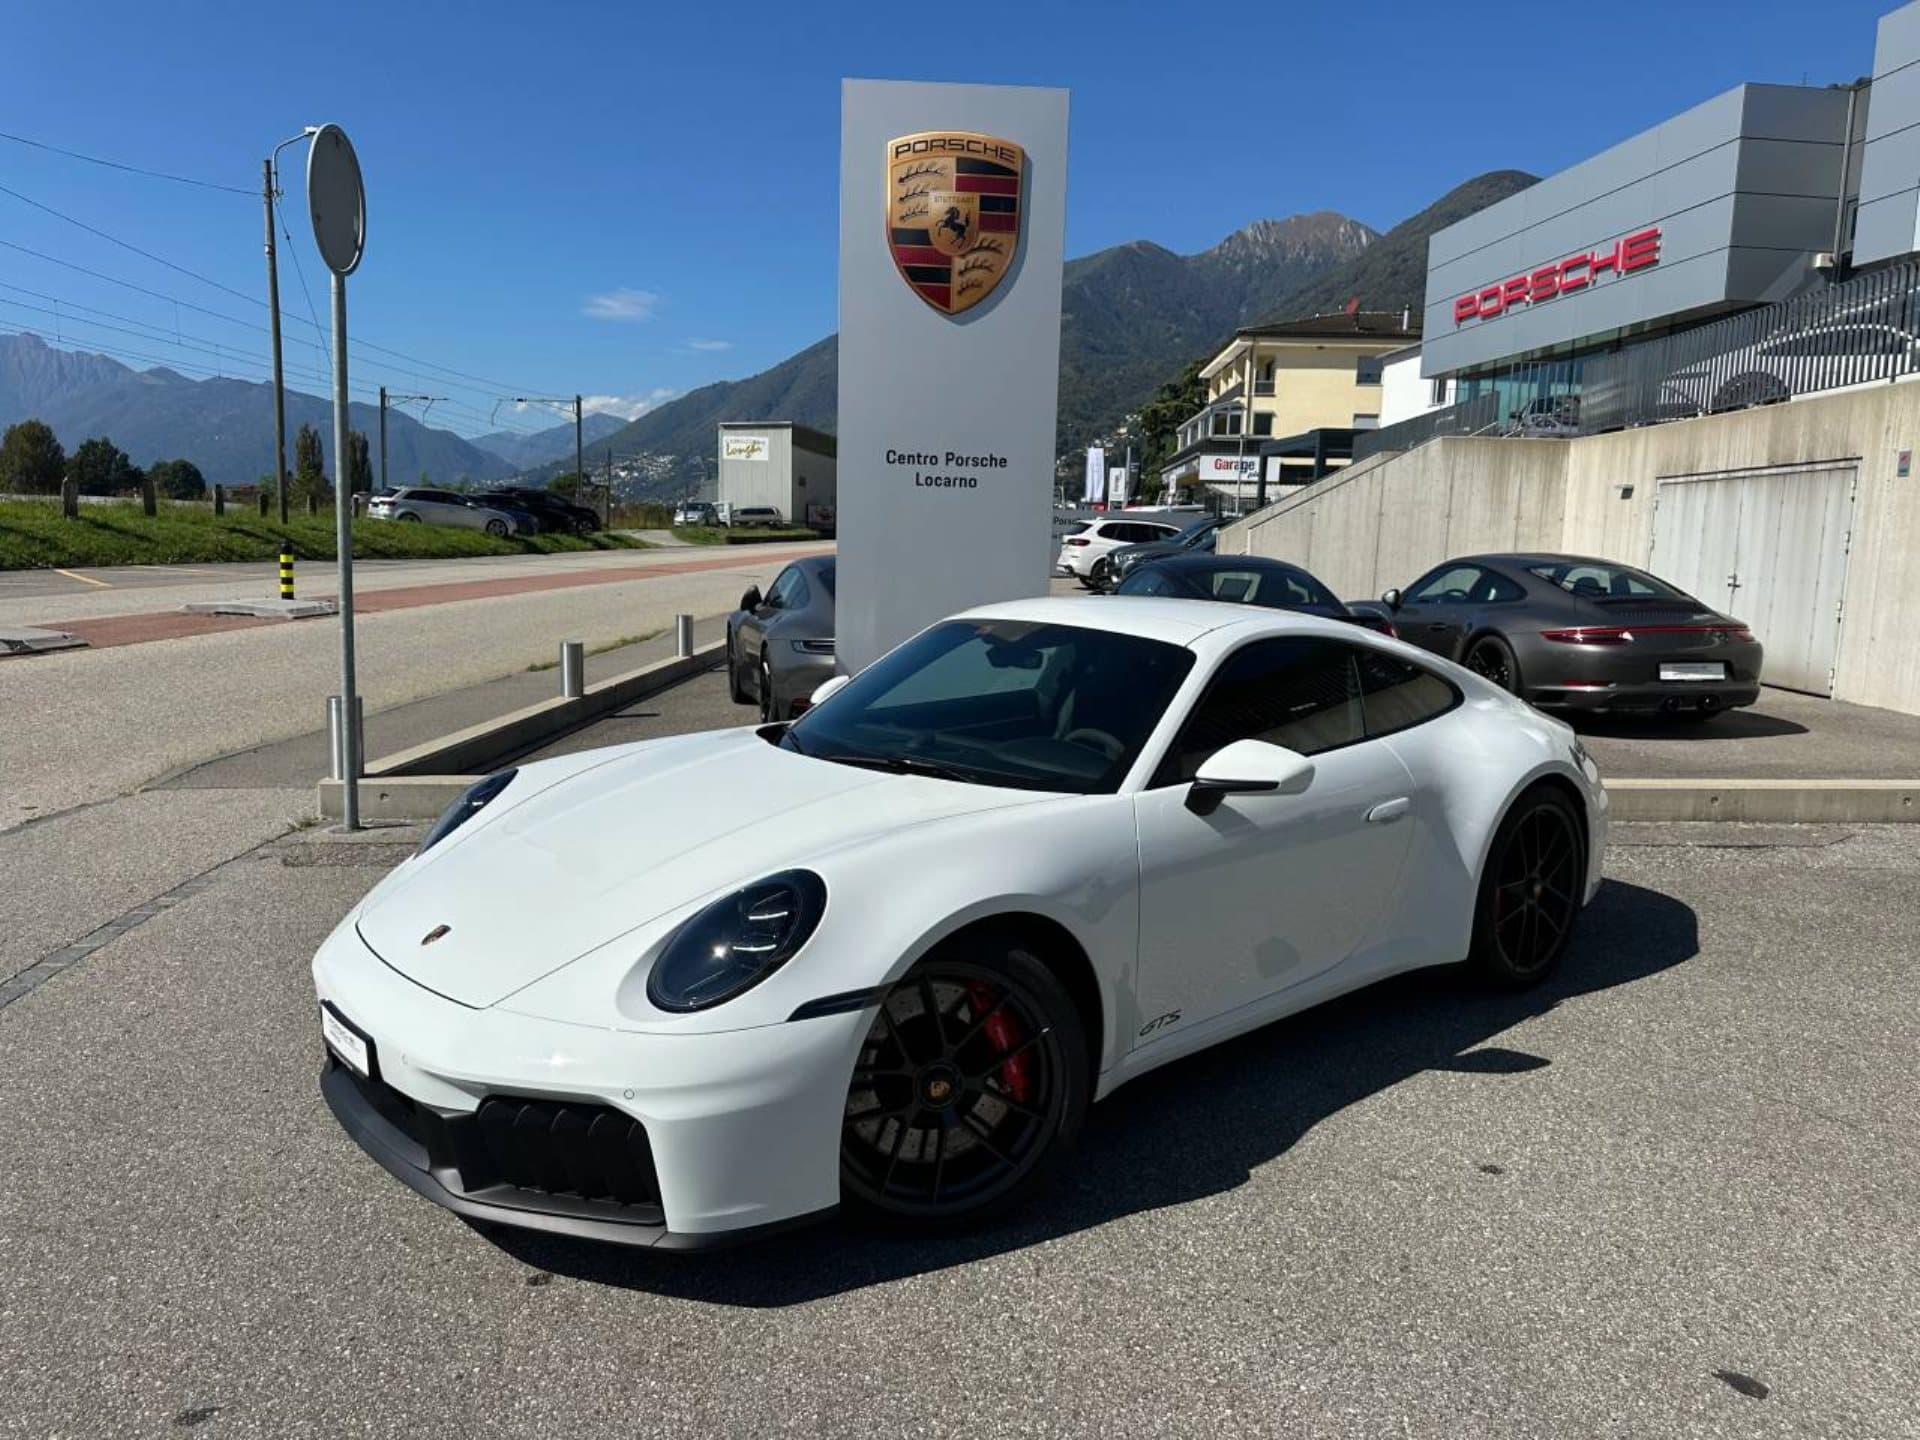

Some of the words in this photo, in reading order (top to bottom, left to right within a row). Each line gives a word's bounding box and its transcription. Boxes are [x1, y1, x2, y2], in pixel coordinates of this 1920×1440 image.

[895, 138, 1016, 164] PORSCHE
[1454, 228, 1662, 328] PORSCHE
[886, 449, 939, 466] Centro
[945, 452, 1008, 468] Porsche
[1214, 458, 1255, 473] Garage
[915, 472, 978, 488] Locarno
[1139, 1009, 1182, 1036] GTS
